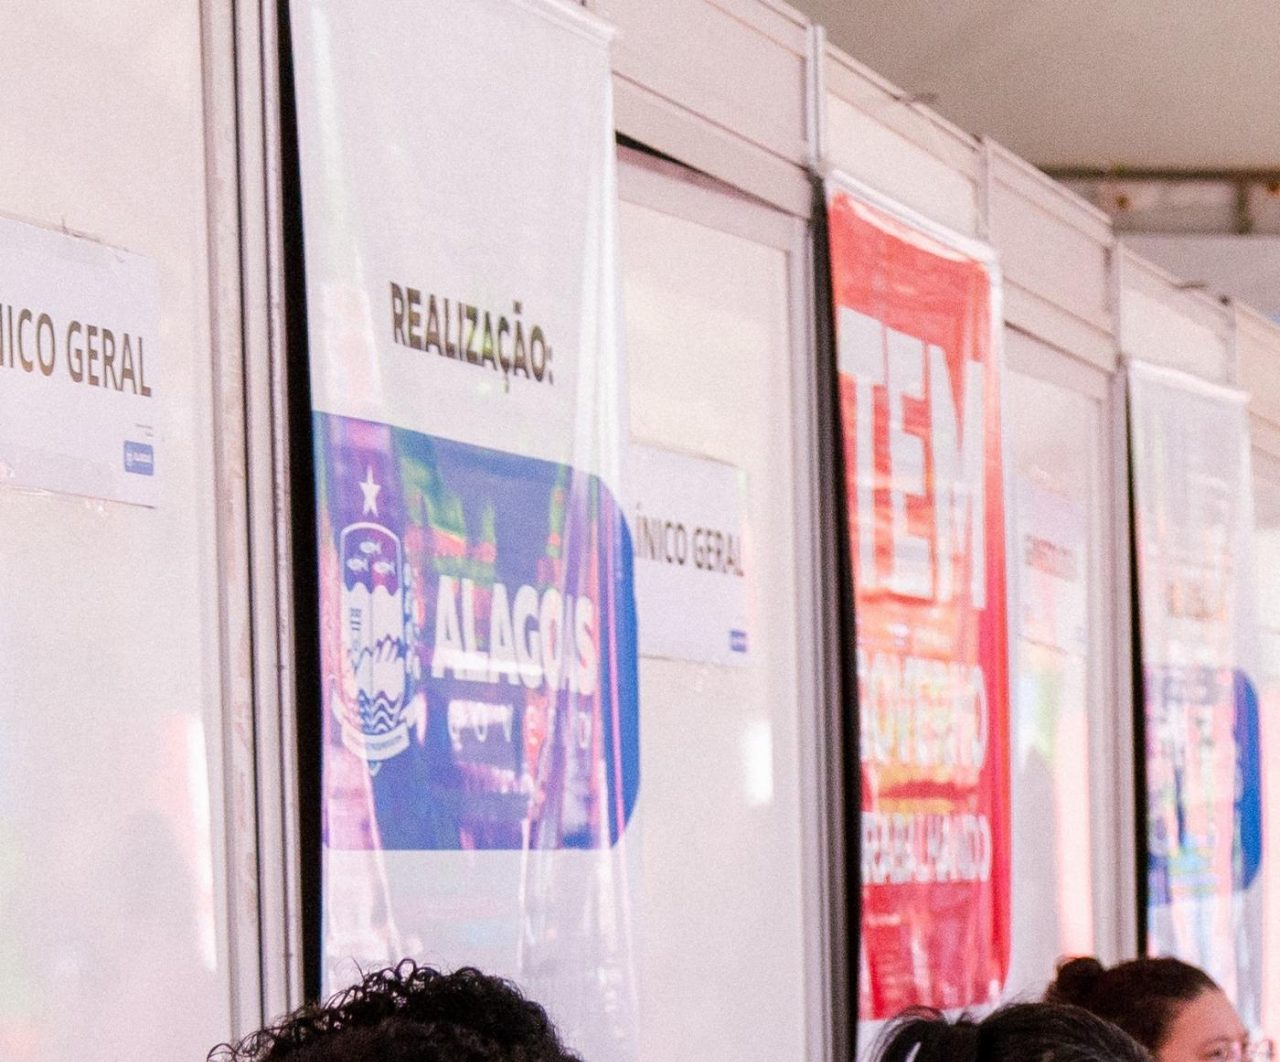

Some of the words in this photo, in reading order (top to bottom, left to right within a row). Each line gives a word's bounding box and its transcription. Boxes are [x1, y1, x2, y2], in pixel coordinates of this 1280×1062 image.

[0, 303, 56, 377] ICO
[66, 320, 152, 397] GERAL
[390, 281, 553, 393] REALIZAÇÃO:
[838, 305, 985, 609] TEM
